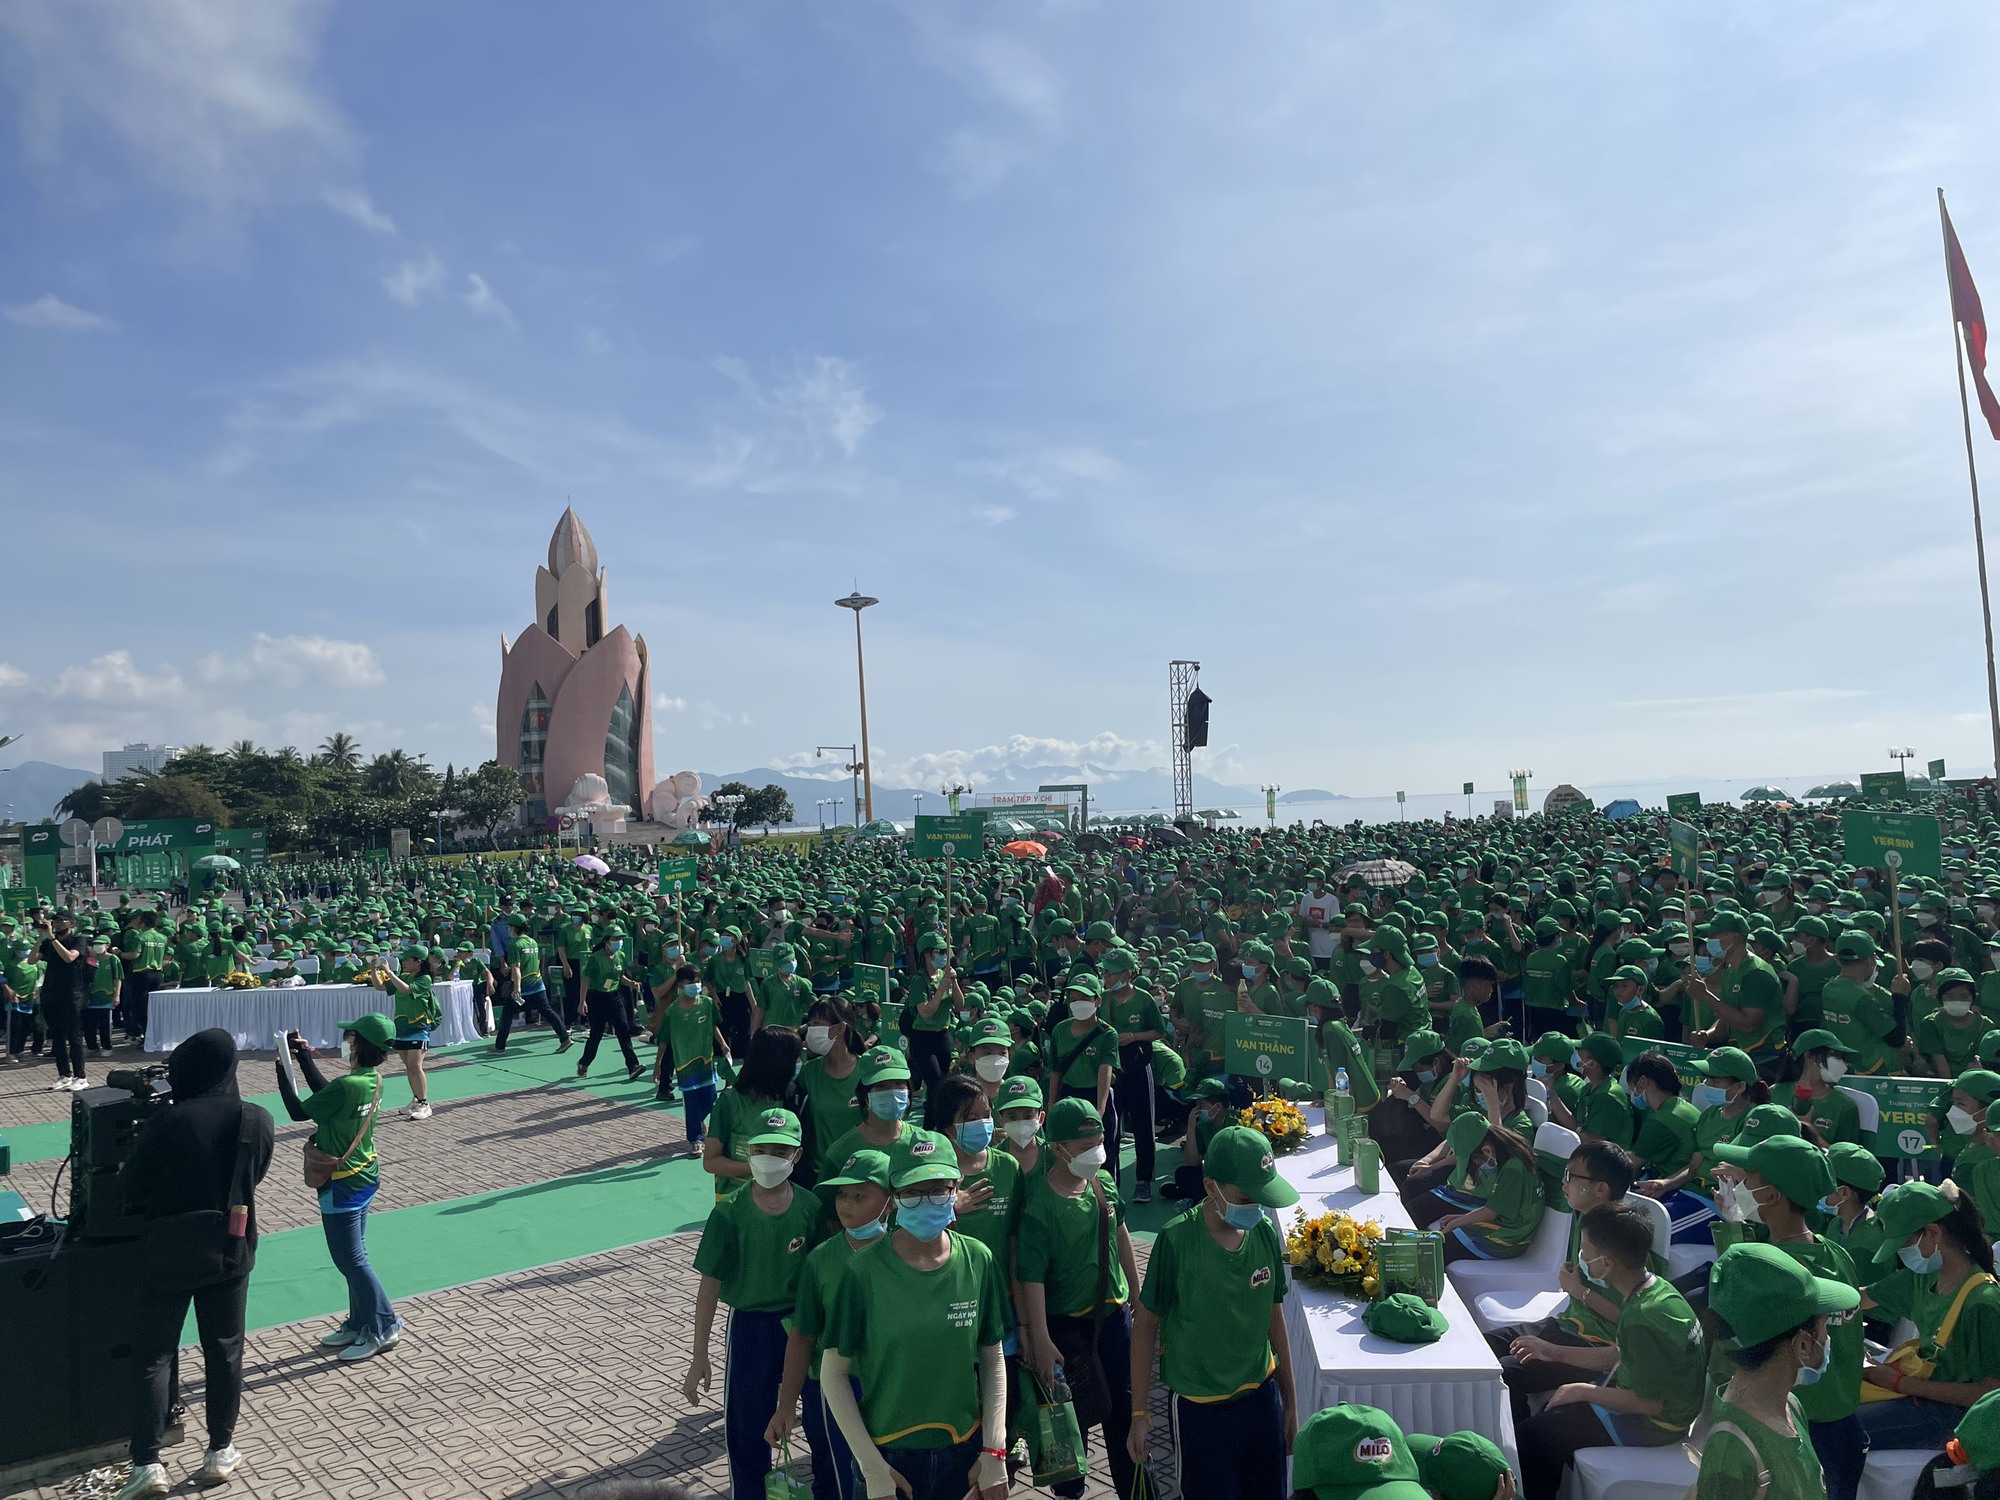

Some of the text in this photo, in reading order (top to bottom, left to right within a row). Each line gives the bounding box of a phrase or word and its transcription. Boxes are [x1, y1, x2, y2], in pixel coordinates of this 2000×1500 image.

[128, 833, 173, 848] PHÁT
[214, 839, 229, 847] CH
[1872, 835, 1915, 849] YERSIN
[1235, 1039, 1295, 1055] VẠN THẮNG
[1258, 1059, 1270, 1071] 14
[1879, 1111, 1928, 1125] YERS
[914, 1145, 934, 1153] MILO
[1902, 1136, 1920, 1149] 17
[1360, 1445, 1389, 1457] MILO
